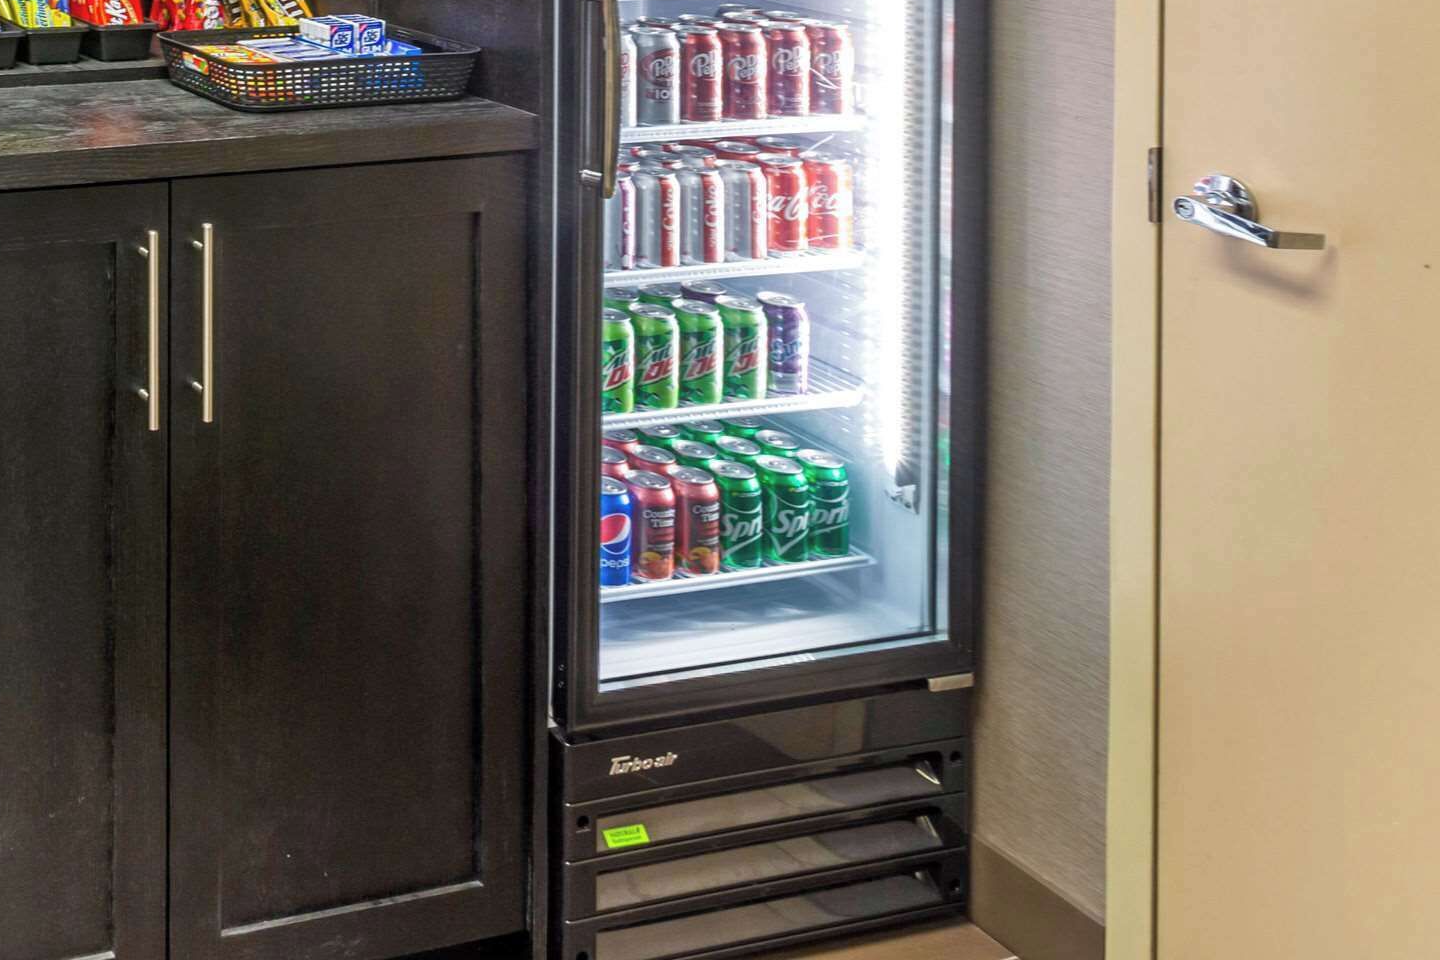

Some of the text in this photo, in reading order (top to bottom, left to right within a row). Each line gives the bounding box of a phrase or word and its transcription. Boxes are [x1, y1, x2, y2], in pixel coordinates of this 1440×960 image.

[600, 558, 630, 570] peps
[609, 751, 678, 776] Turbo air
